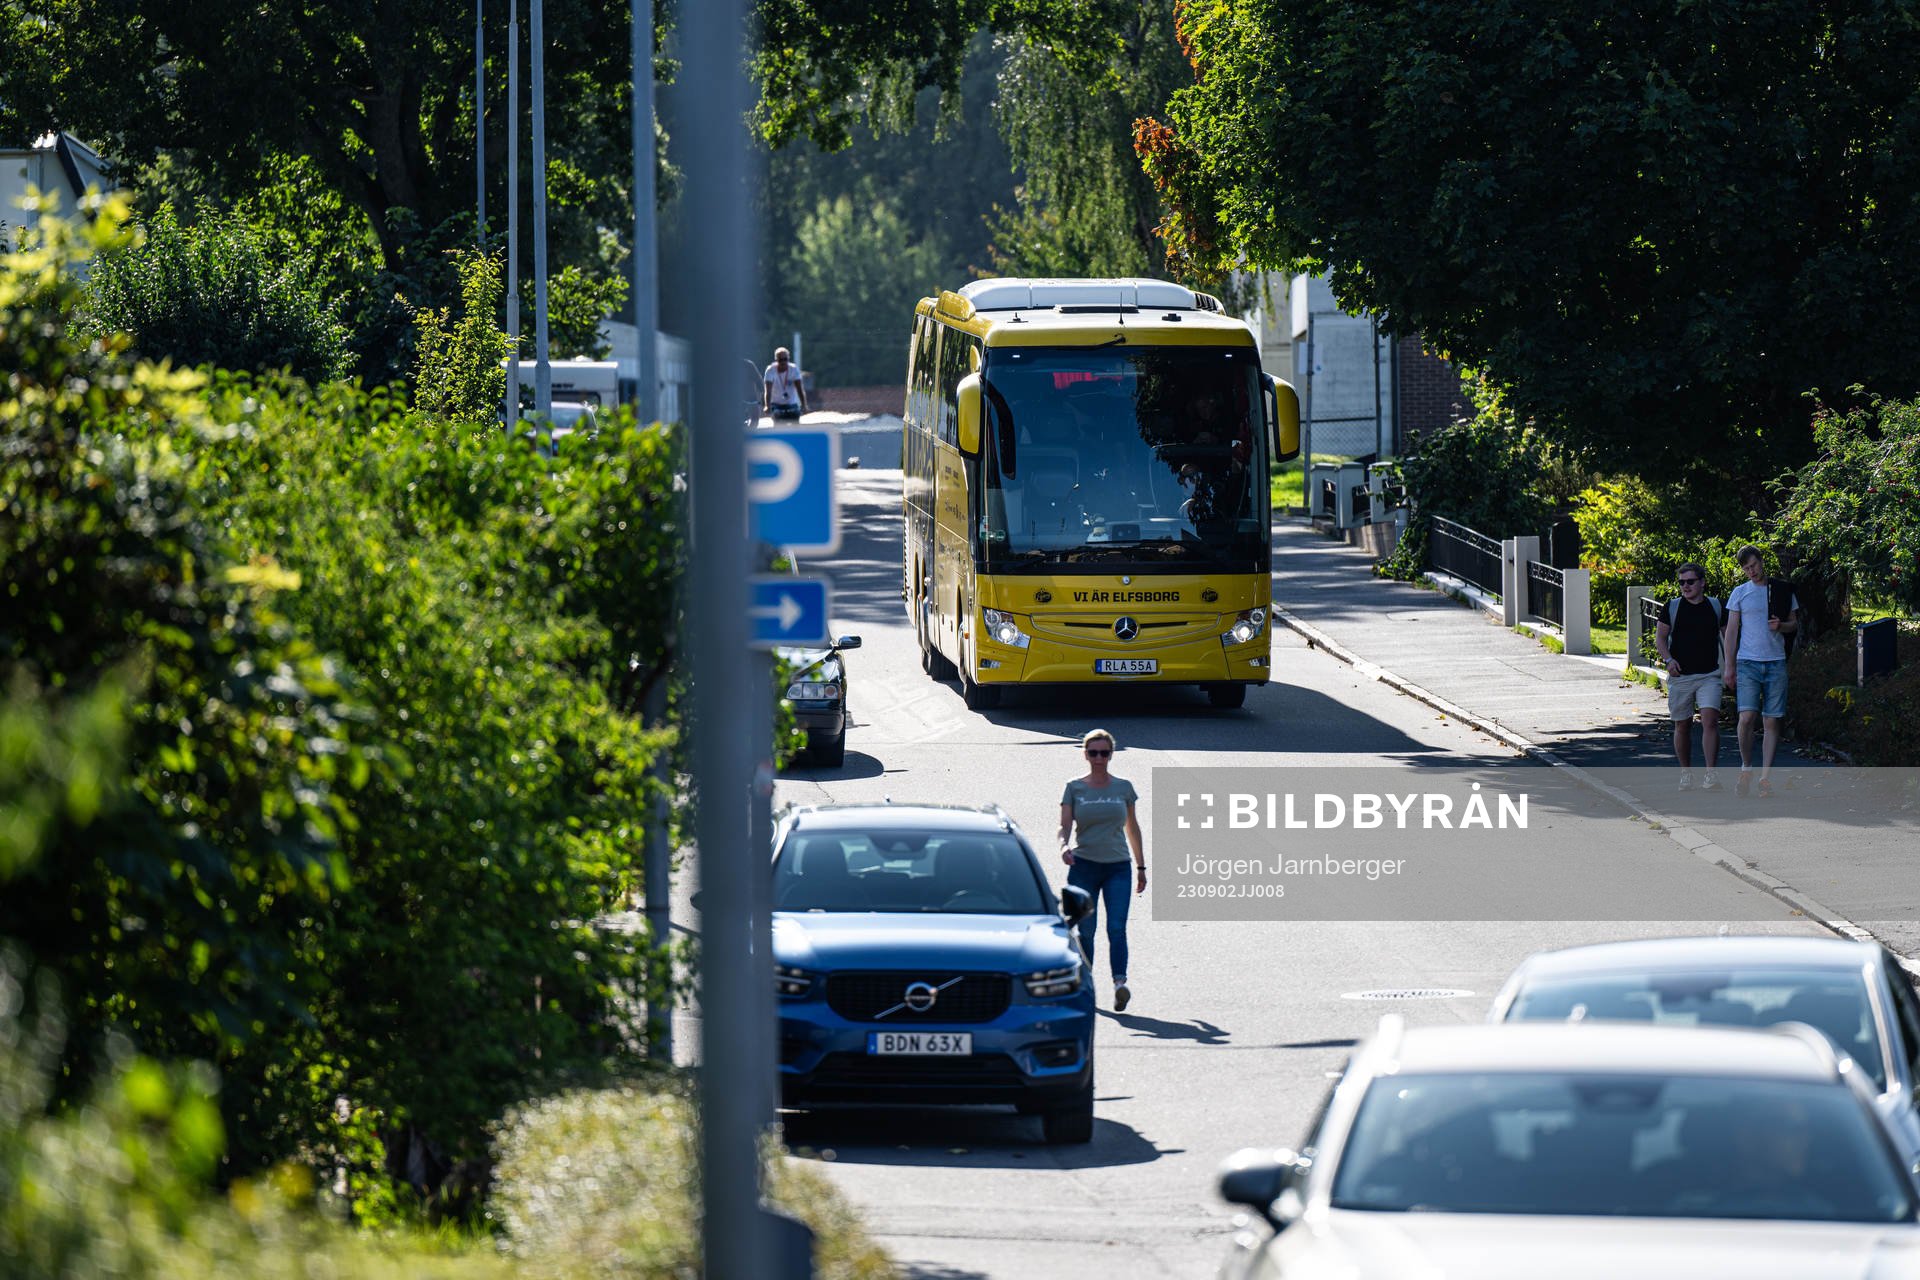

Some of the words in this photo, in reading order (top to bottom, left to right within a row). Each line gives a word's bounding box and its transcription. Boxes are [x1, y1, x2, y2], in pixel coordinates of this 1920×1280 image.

[746, 439, 804, 504] P
[1074, 591, 1089, 602] VI
[1092, 589, 1109, 602] ÄR
[1113, 591, 1180, 602] ELFSBORG
[1105, 660, 1127, 671] RLA
[1130, 660, 1152, 671] 55A
[884, 1035, 920, 1052] BDN
[926, 1035, 963, 1052] 63X
